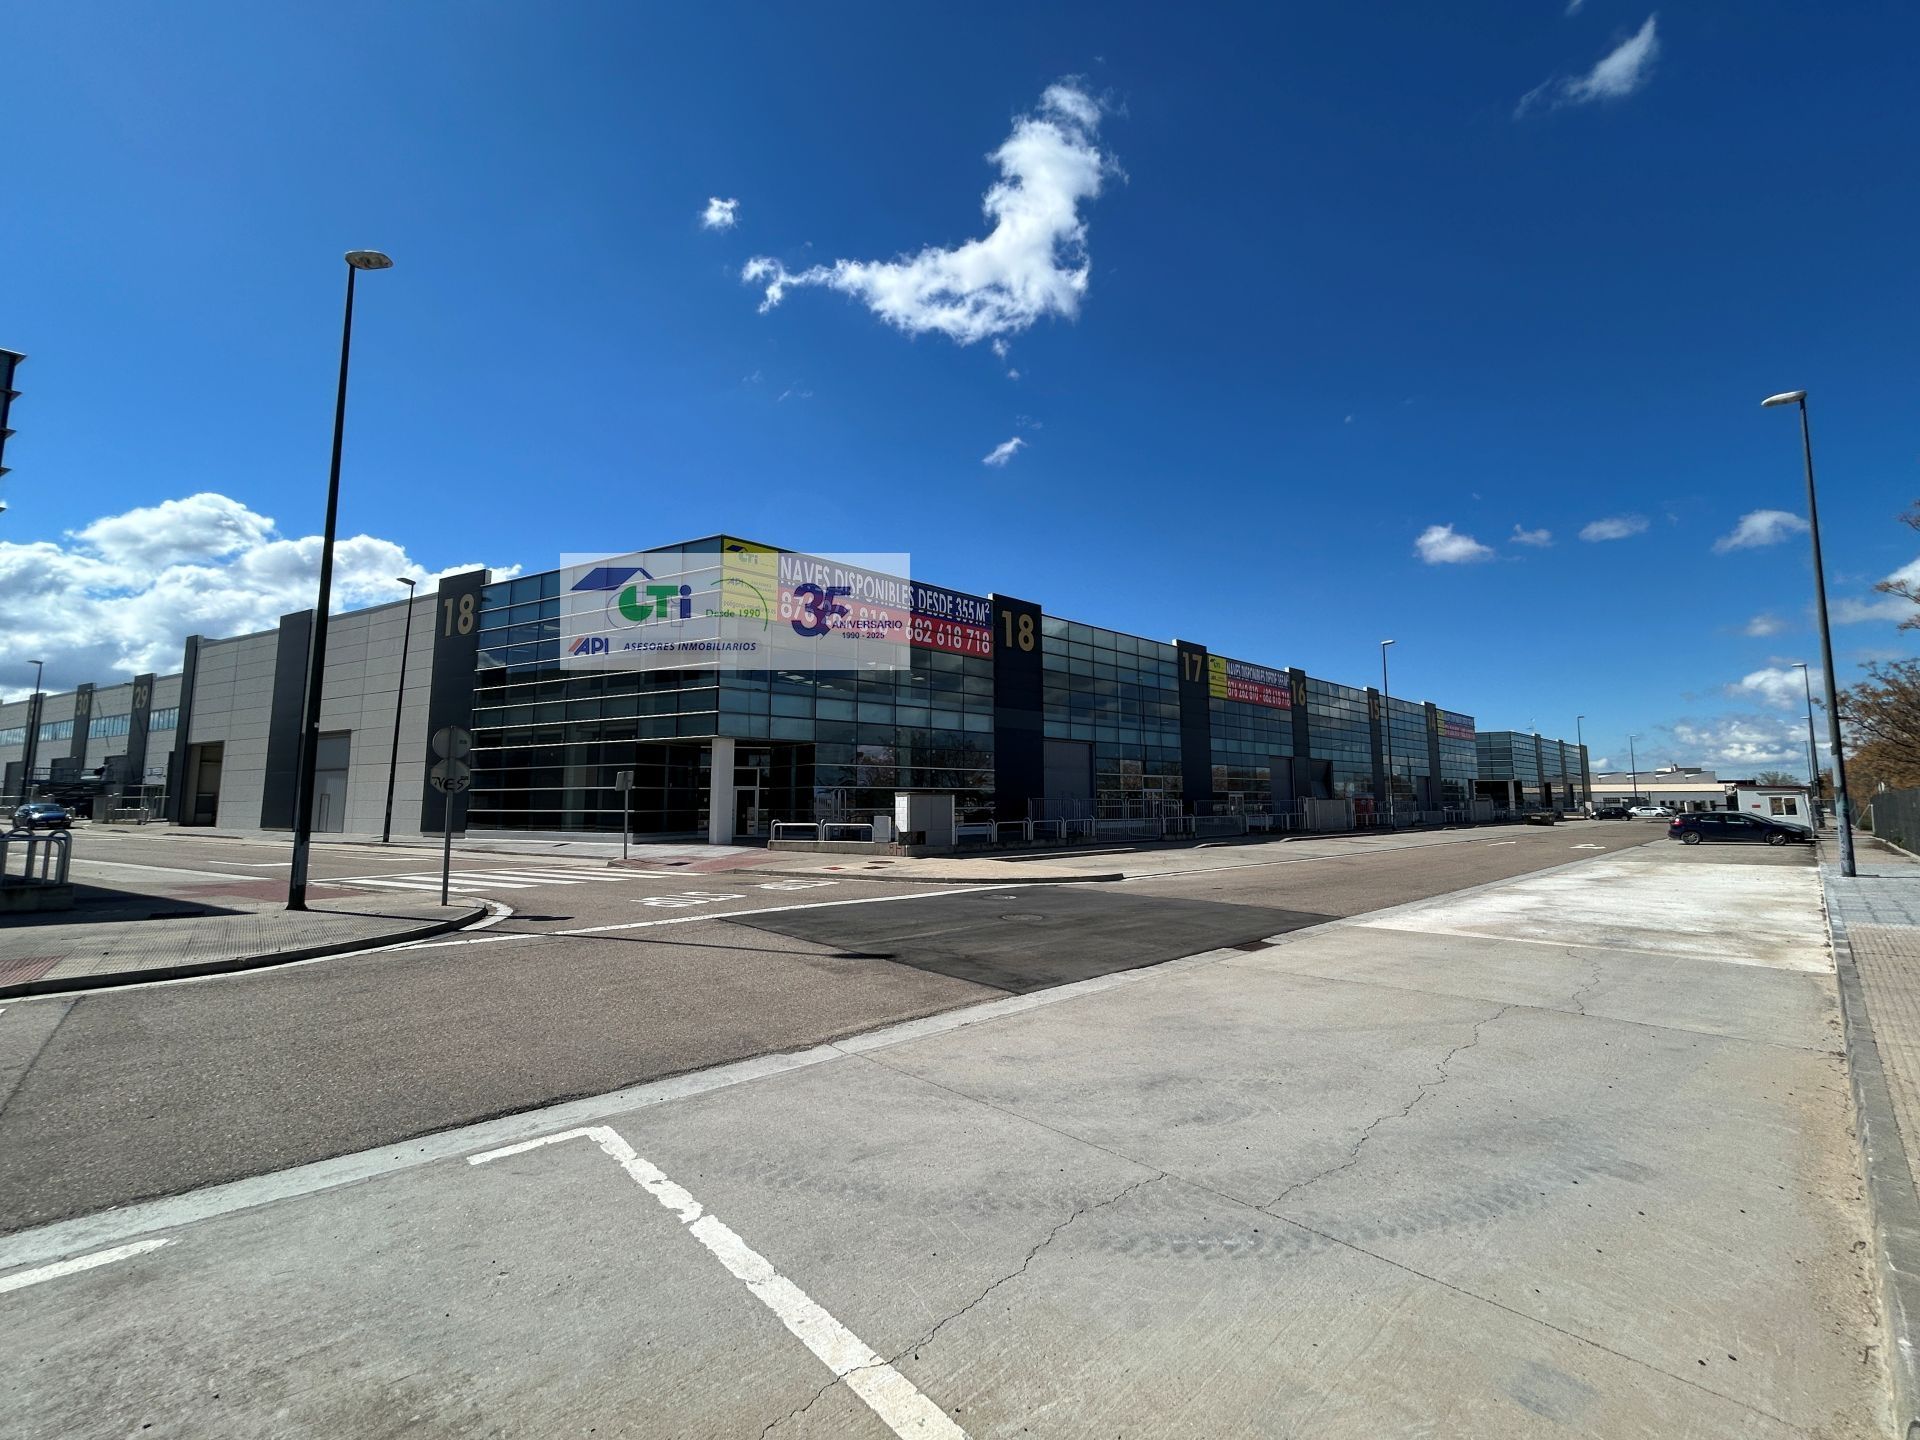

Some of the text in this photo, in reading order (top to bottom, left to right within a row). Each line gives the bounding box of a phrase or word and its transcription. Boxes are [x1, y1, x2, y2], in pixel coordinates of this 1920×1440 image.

[780, 556, 990, 626] NAVES DISPONIBLES DESDE 355 M²
[444, 594, 475, 637] 18
[1001, 610, 1034, 651] 18
[905, 618, 932, 643] 682
[936, 623, 962, 648] 618
[966, 629, 990, 653] 718
[1182, 651, 1203, 682] 17
[135, 685, 149, 709] 29
[1291, 681, 1305, 706] 16
